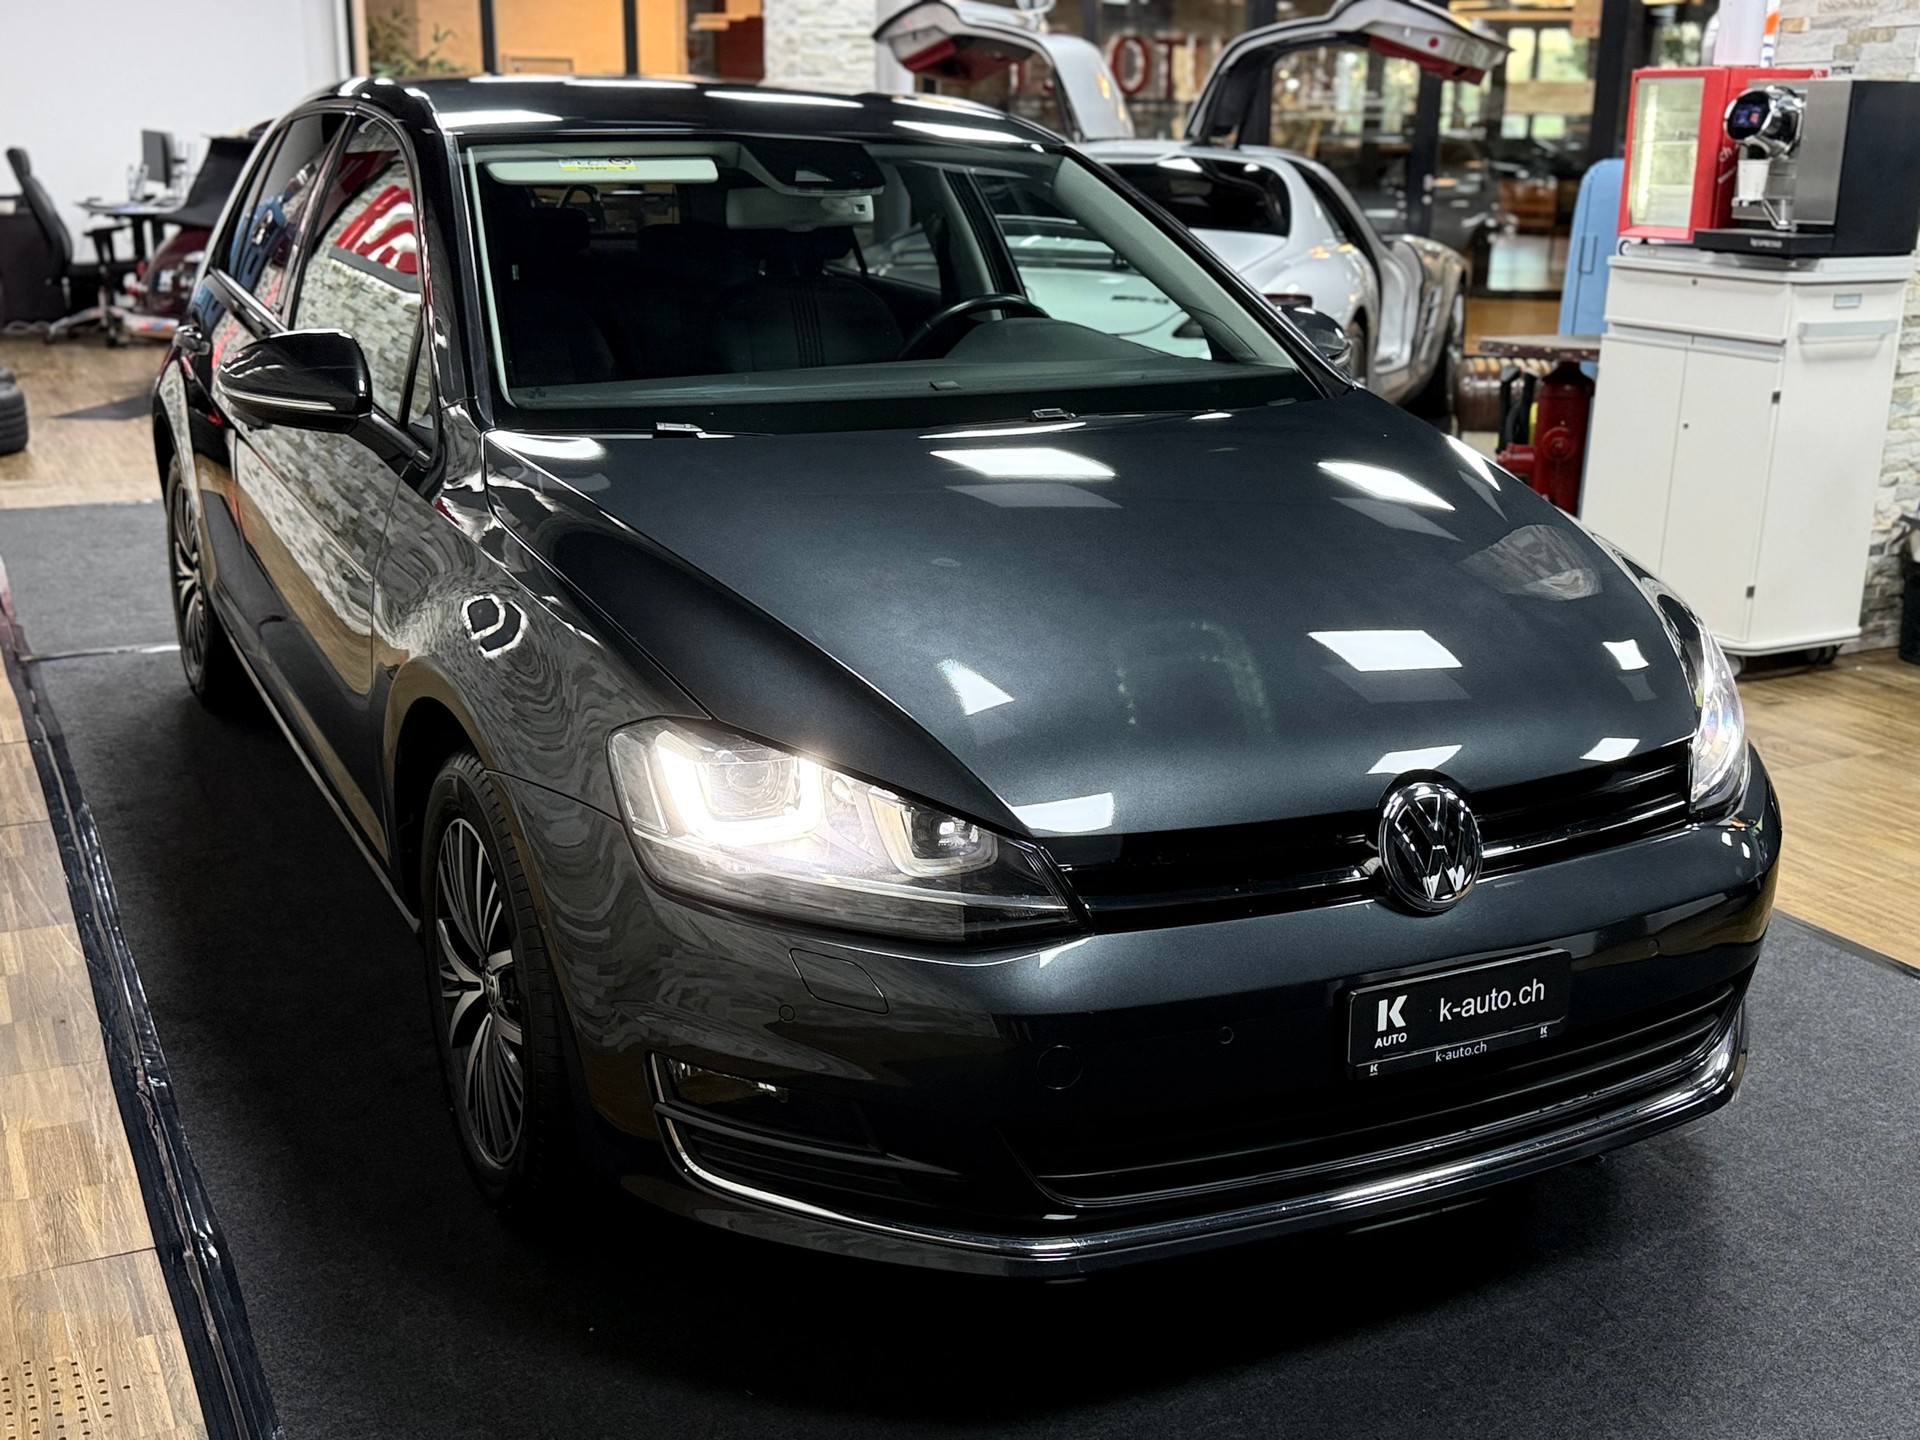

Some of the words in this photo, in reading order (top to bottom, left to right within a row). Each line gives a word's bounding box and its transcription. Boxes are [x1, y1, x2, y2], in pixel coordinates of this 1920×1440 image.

[1377, 994, 1408, 1032] K
[1439, 978, 1545, 1023] k-auto.ch
[1374, 1032, 1408, 1049] AUTO
[1435, 1041, 1487, 1063] k-auto.ch
